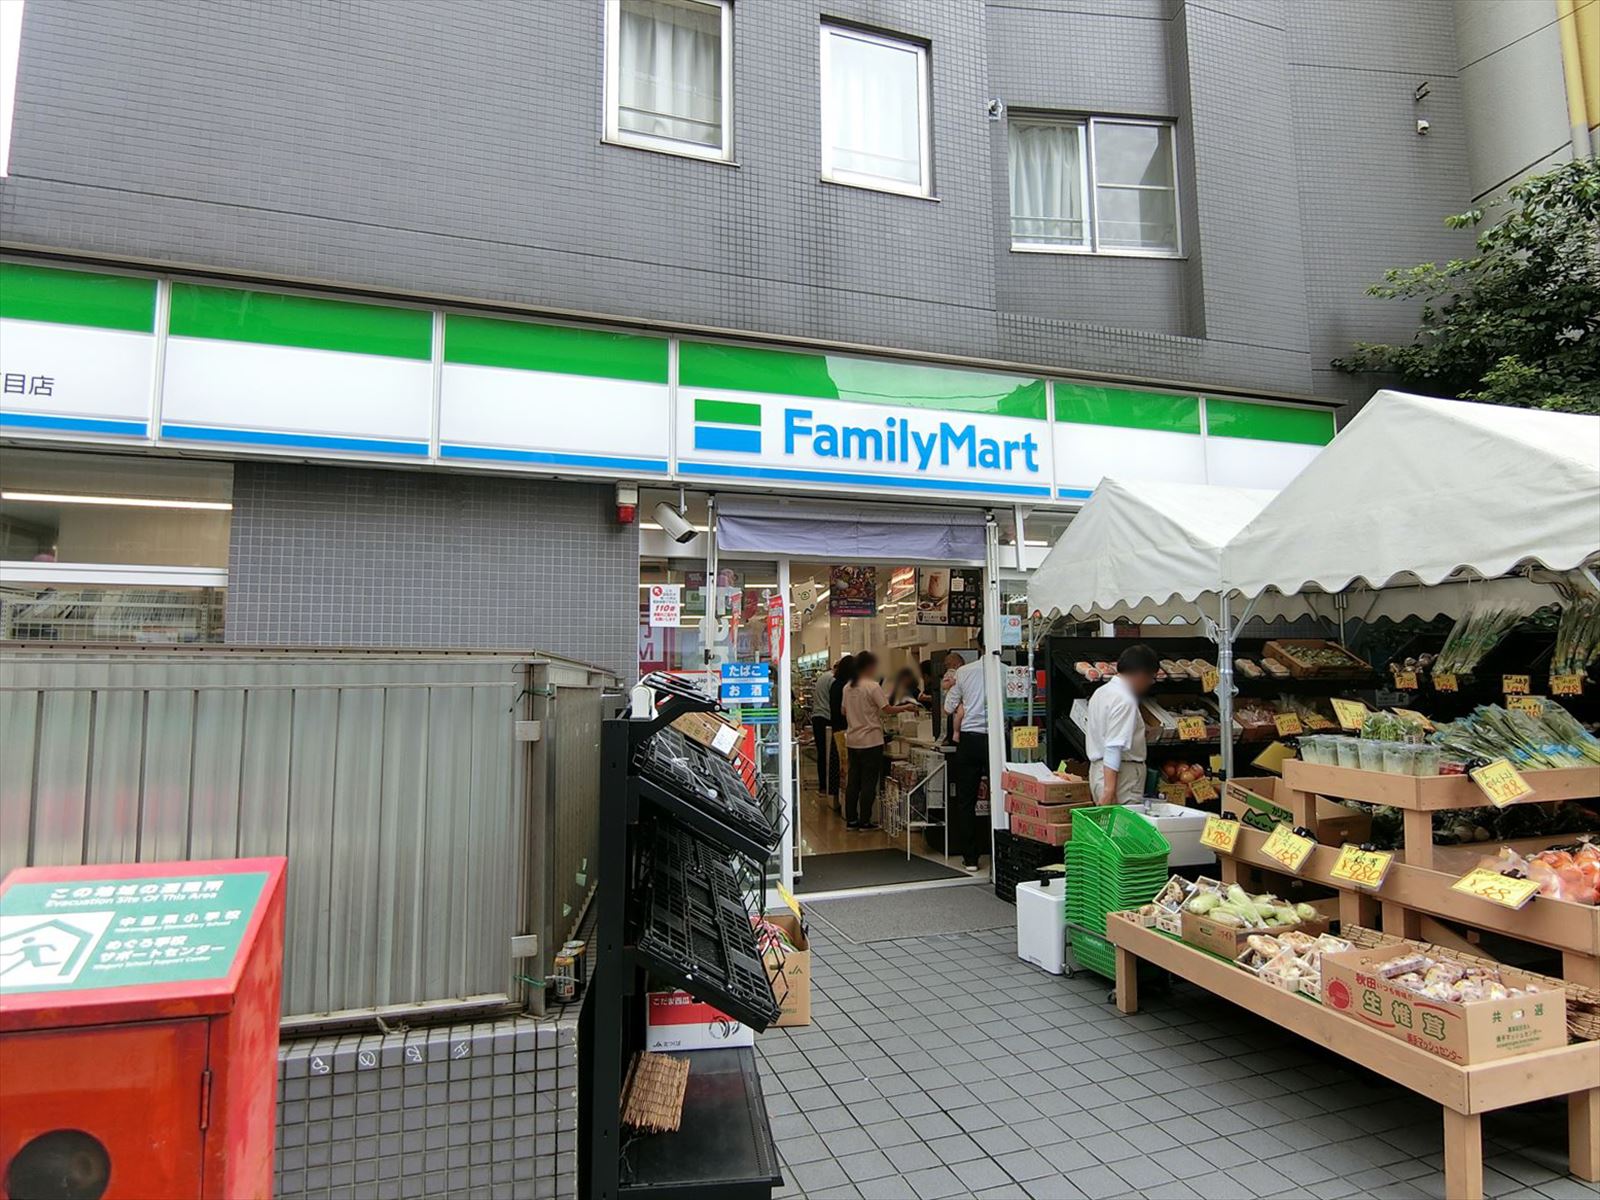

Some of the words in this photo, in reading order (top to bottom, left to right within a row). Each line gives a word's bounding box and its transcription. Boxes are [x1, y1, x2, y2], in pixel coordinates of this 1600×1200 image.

[0, 372, 55, 396] 目店
[784, 407, 1040, 473] FamilyMart
[729, 665, 762, 677] たばこ
[100, 945, 226, 963] サポートセンター
[1362, 989, 1446, 1041] 生椎茸
